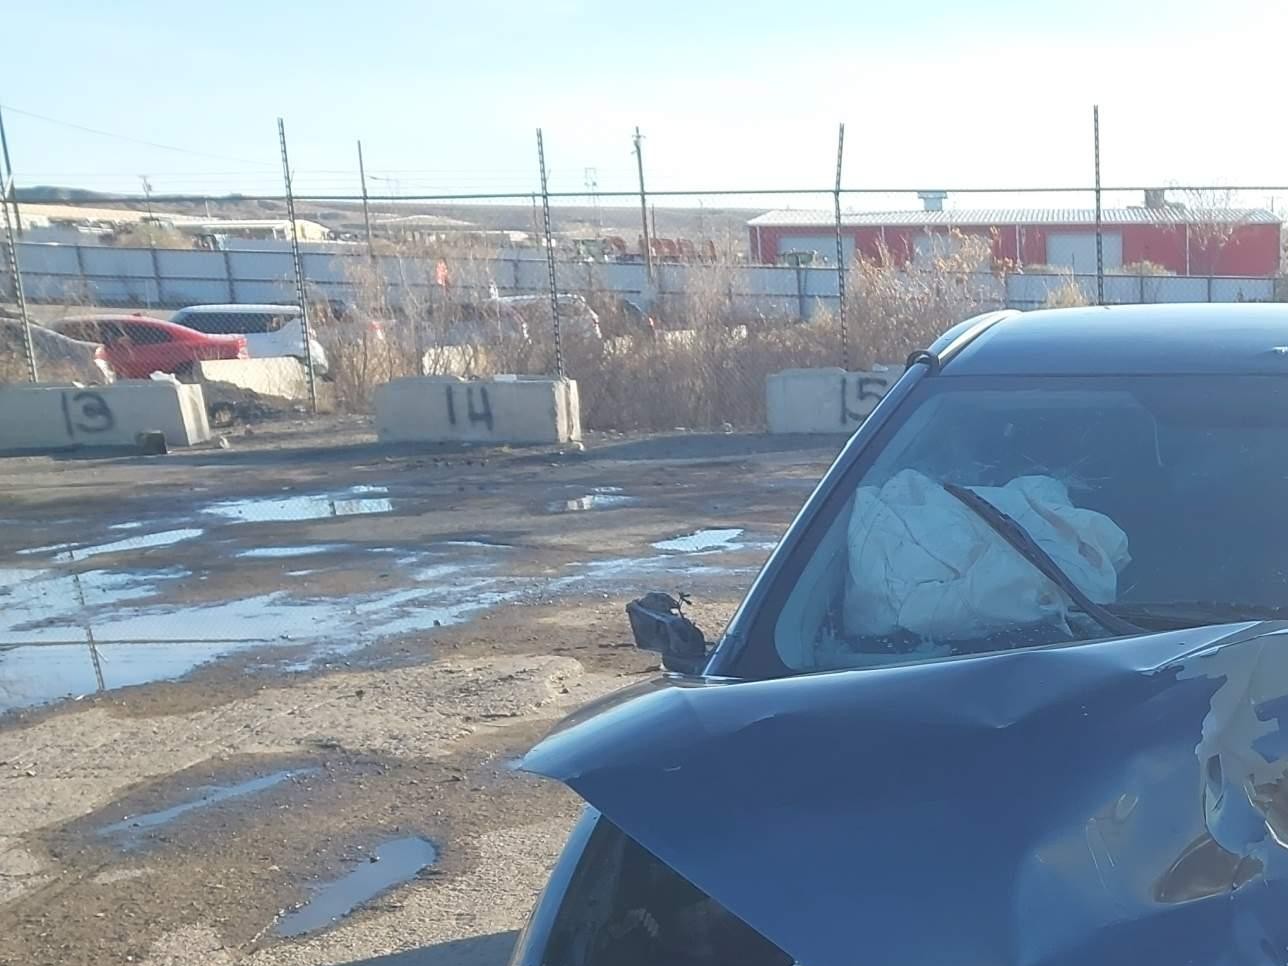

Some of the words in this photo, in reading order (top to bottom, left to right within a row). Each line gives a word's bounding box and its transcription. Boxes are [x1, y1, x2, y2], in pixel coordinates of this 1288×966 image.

[61, 391, 115, 438] 13
[446, 385, 494, 432] 14
[841, 377, 888, 424] 15
